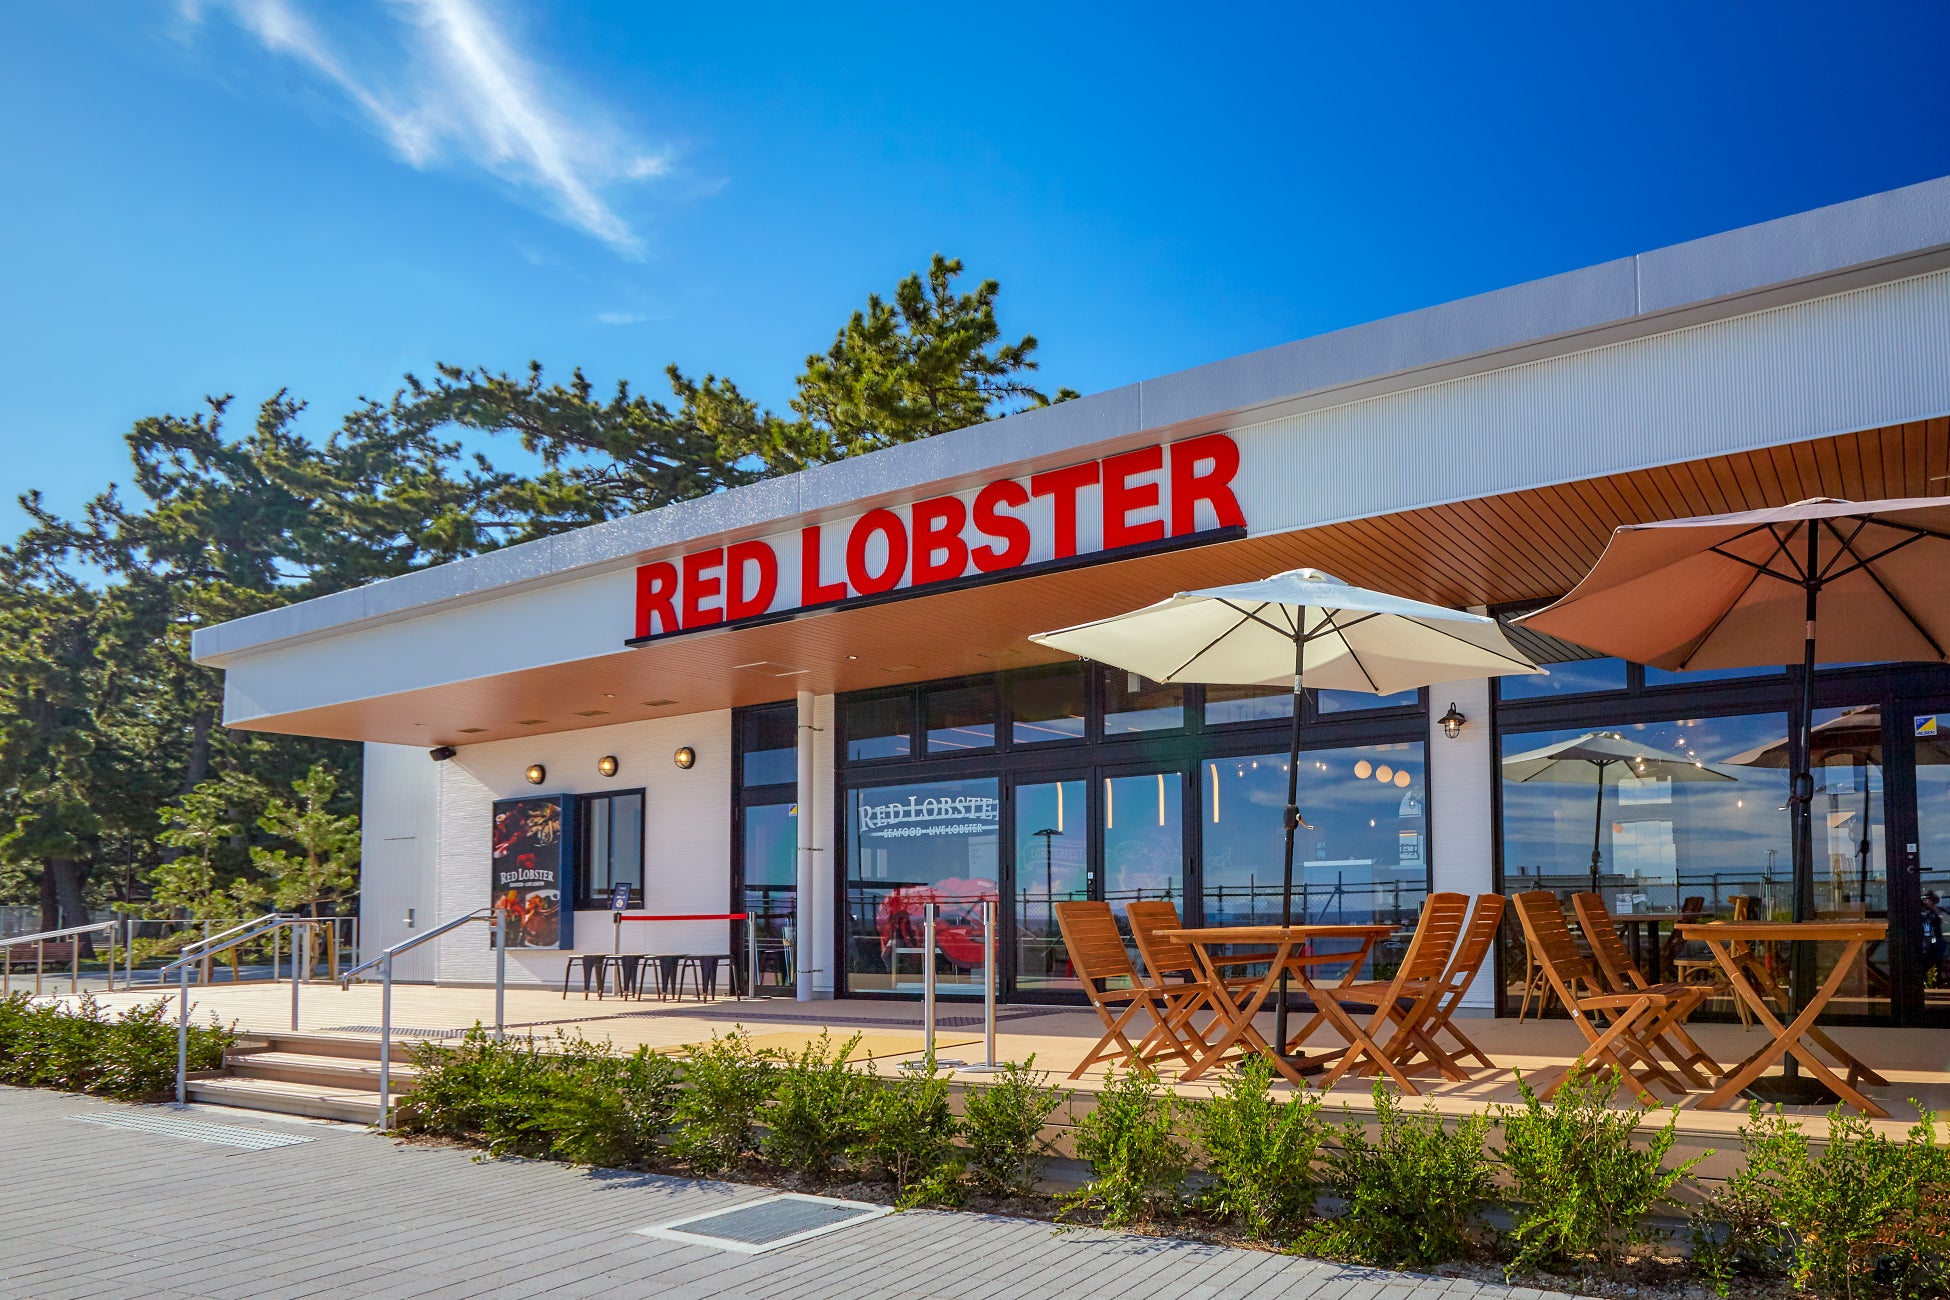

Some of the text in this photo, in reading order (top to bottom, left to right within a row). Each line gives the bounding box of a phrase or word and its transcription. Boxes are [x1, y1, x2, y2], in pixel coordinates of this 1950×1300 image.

[635, 433, 1248, 638] RED LOBSTER
[859, 795, 999, 832] RED LOBSTE
[883, 823, 983, 838] SEAFOOD LIVE LOBSTER
[500, 872, 518, 885] RED
[518, 868, 554, 882] LOBSTER
